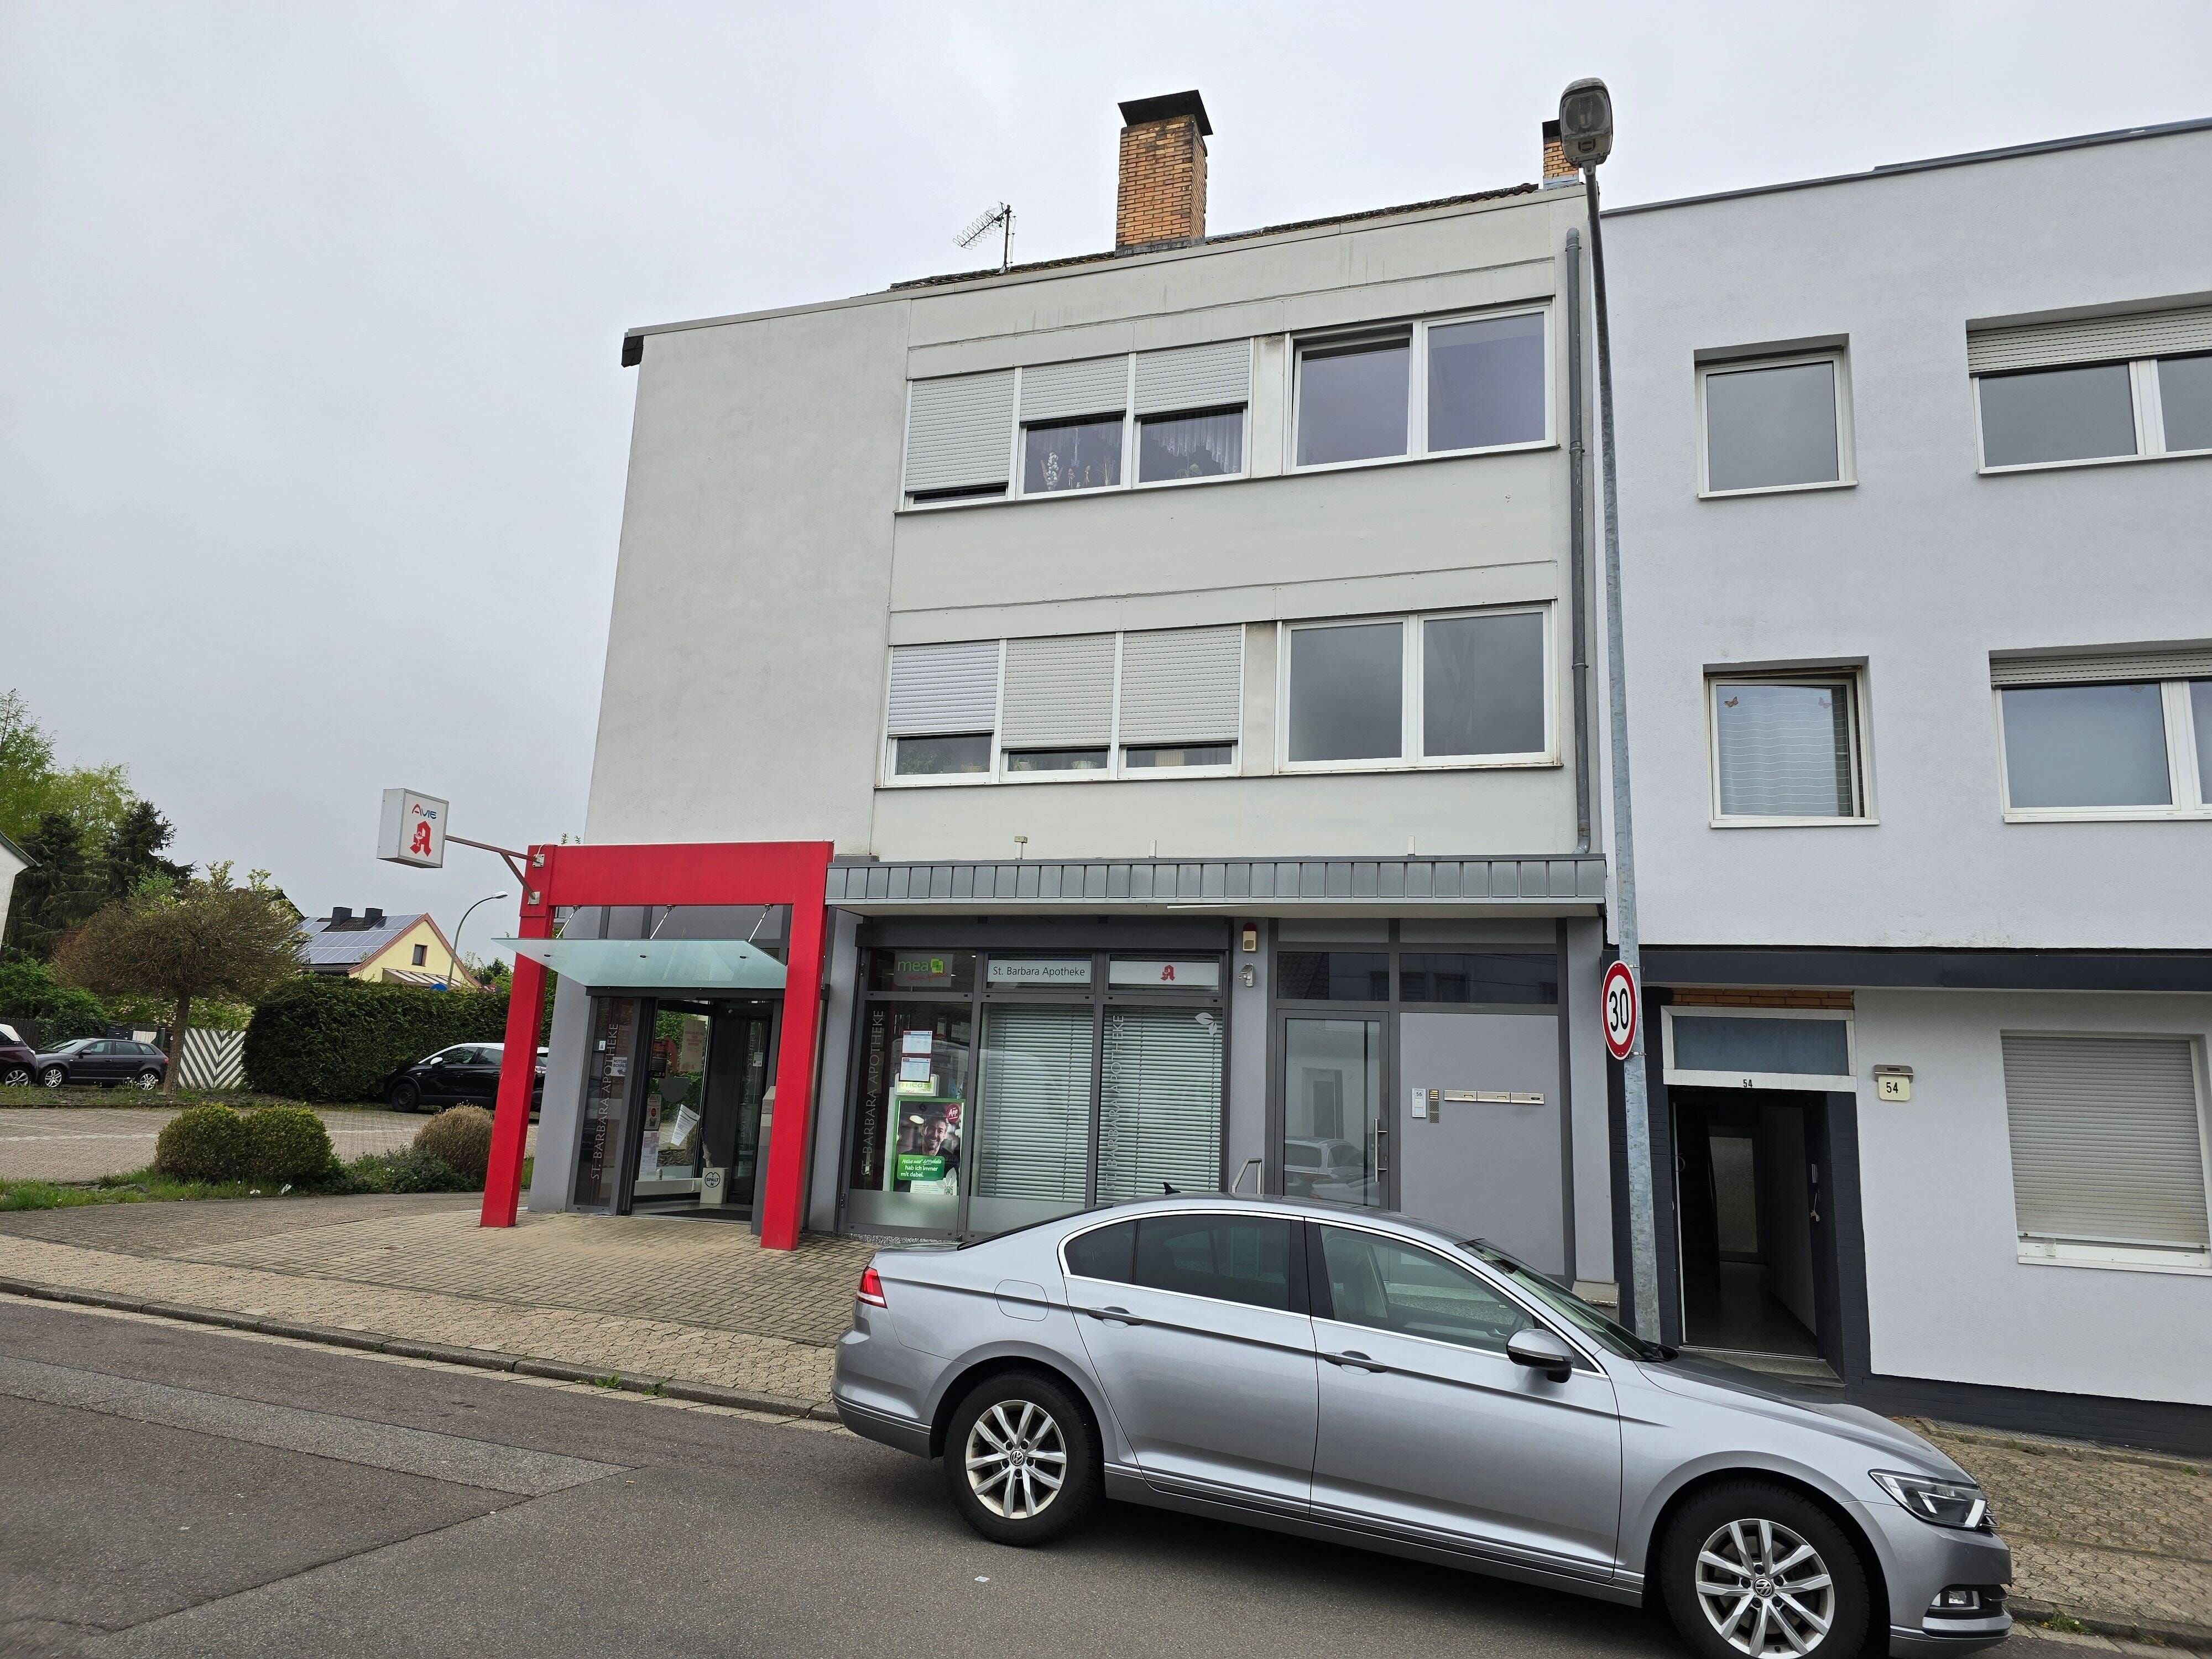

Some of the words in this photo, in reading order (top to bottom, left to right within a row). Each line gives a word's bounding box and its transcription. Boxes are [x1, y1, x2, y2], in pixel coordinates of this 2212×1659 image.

[898, 961, 928, 972] mea
[993, 967, 1003, 975] St.
[1006, 967, 1040, 975] Barbara
[1042, 967, 1085, 977] Apotheke
[1609, 988, 1629, 1032] 30
[601, 1024, 619, 1093] APOTHEKE
[868, 1010, 884, 1084] APOTHEKE
[1110, 1015, 1124, 1093] APOTHEKE
[1743, 1079, 1753, 1088] 54
[1886, 1082, 1898, 1093] 54
[593, 1097, 609, 1159] BARBARA
[863, 1088, 878, 1154] BARBARA
[1107, 1099, 1120, 1167] BARBARA
[591, 1164, 601, 1180] ST.
